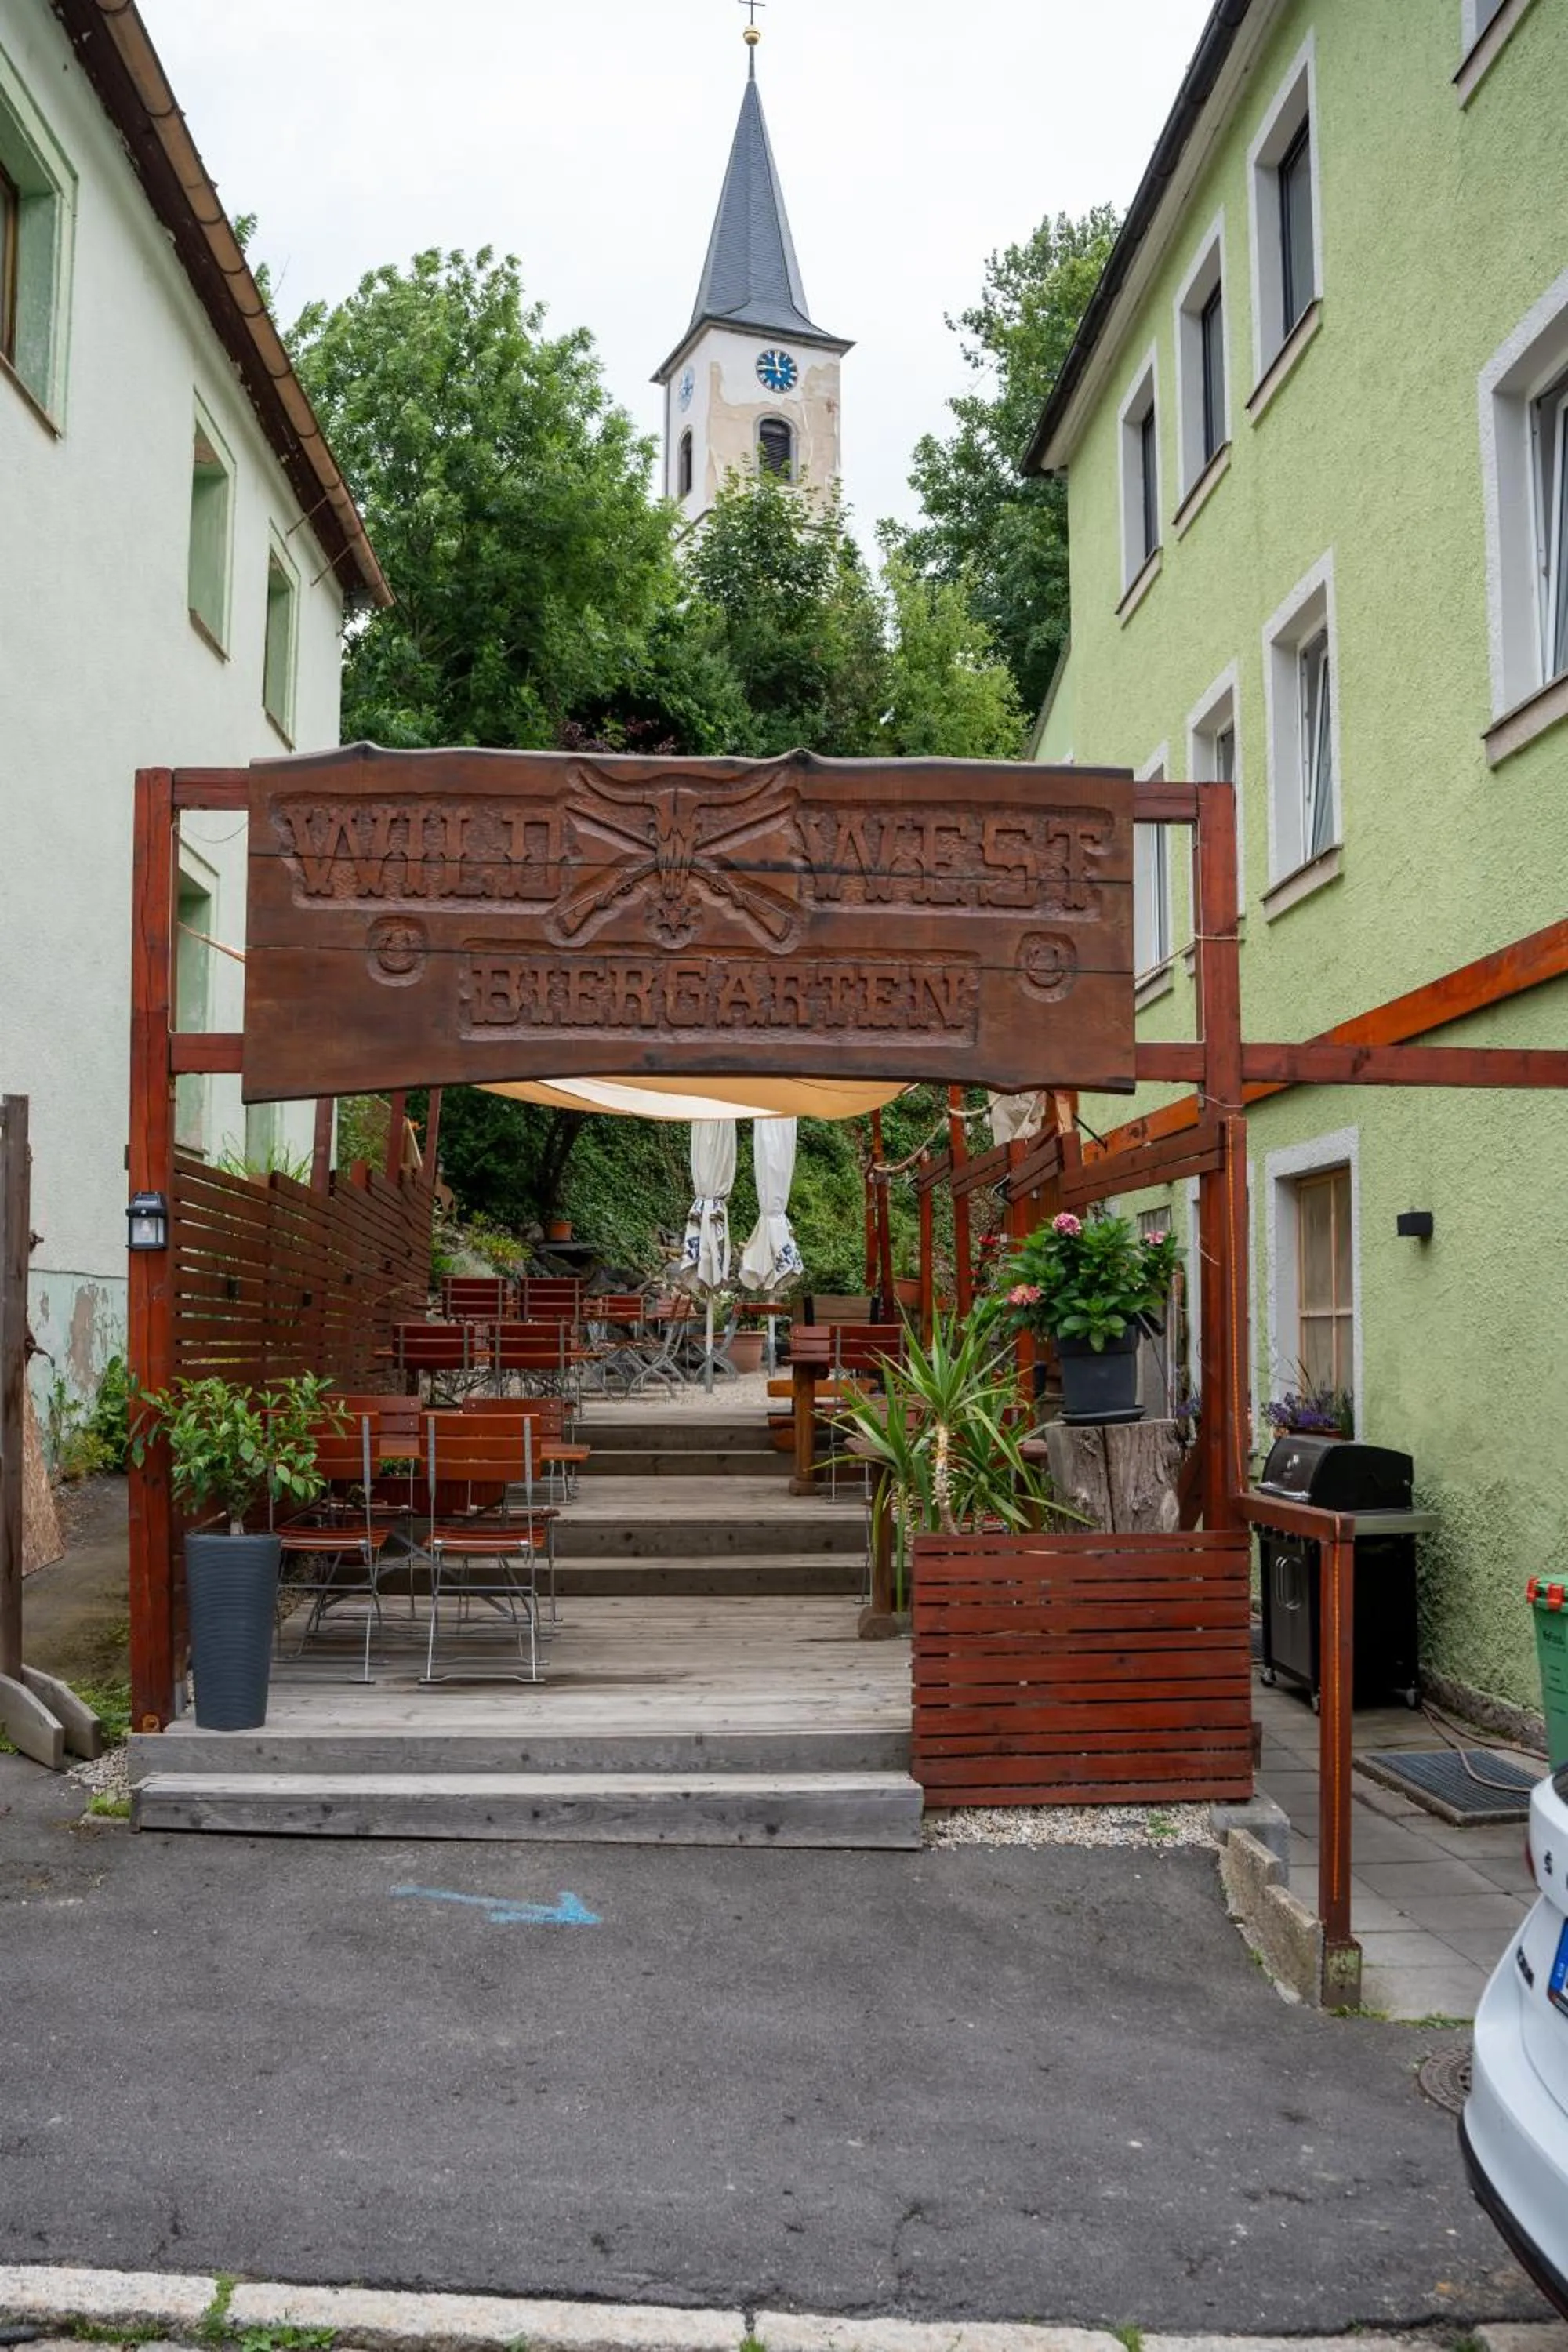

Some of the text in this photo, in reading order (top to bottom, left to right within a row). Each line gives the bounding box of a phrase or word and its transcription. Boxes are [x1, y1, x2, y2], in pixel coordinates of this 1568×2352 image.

[284, 804, 1110, 910] WILD WEST
[471, 964, 964, 1029] BIERGARTEN
